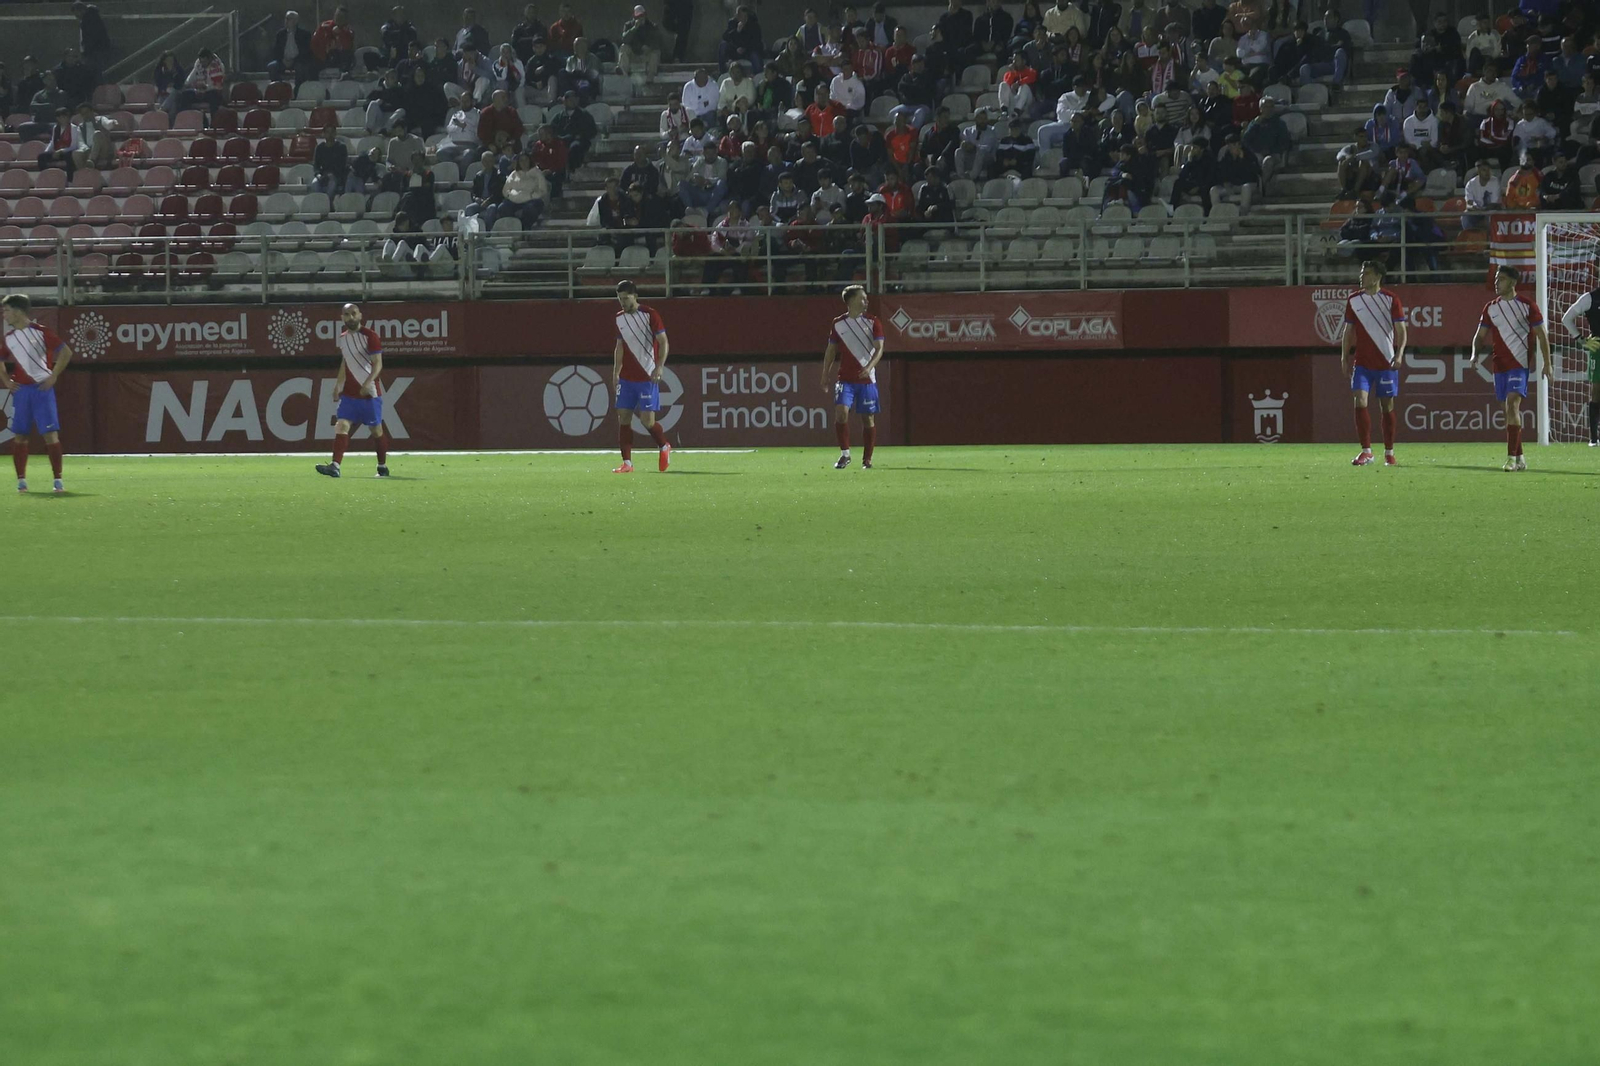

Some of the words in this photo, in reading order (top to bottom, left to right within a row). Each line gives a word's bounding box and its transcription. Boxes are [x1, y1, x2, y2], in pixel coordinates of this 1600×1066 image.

[908, 319, 996, 338] COPLAGA
[1027, 317, 1118, 336] COPLAGA
[1402, 306, 1443, 328] ECSE
[116, 312, 248, 351] apymeal
[702, 365, 798, 395] Fútbol
[702, 399, 828, 430] Emotion
[1404, 402, 1536, 430] Grazalem
